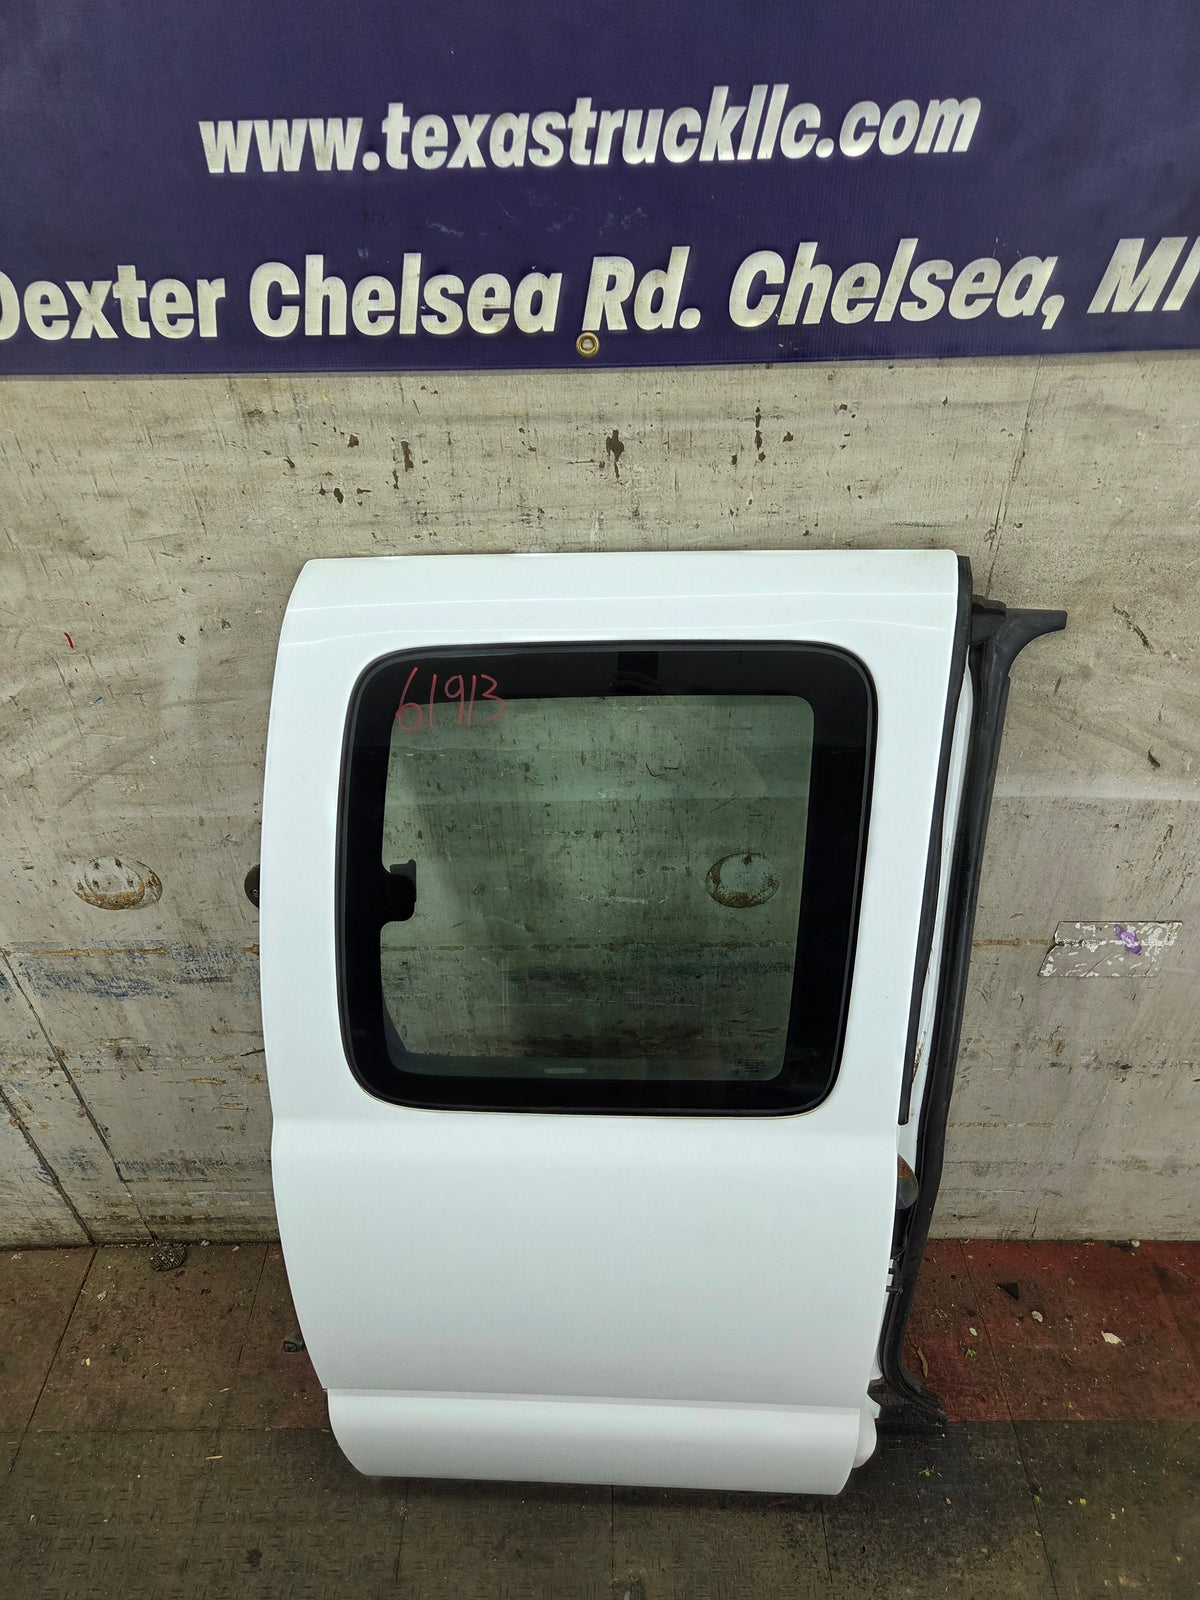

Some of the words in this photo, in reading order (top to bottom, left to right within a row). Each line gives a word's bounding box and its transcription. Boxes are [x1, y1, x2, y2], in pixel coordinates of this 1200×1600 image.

[198, 83, 982, 174] www.texastruckllc.com
[249, 252, 563, 338] Chelsea
[581, 245, 702, 331] Rd.
[728, 237, 1065, 330] Chelsea,
[1086, 235, 1200, 314] MI
[395, 666, 507, 733] 61913
